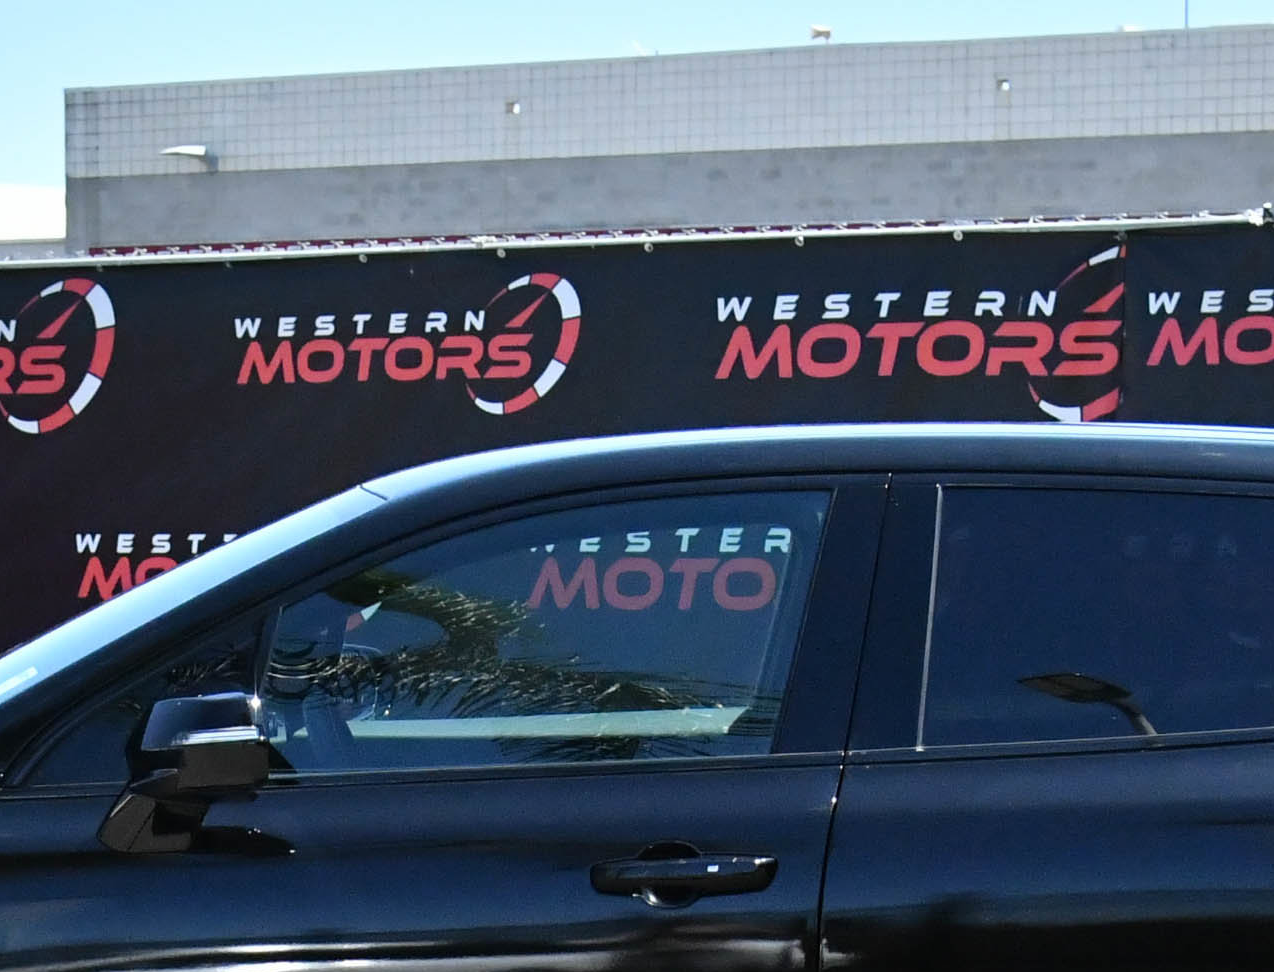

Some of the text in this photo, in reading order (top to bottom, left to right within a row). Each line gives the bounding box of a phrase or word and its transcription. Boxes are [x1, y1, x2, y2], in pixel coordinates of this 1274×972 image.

[234, 310, 485, 339] WESTERN
[717, 290, 1057, 322] WESTERN
[237, 332, 534, 385] MOTORS
[714, 319, 1122, 380] MOTORS
[530, 527, 792, 553] ESTER
[526, 556, 777, 611] MOTO
